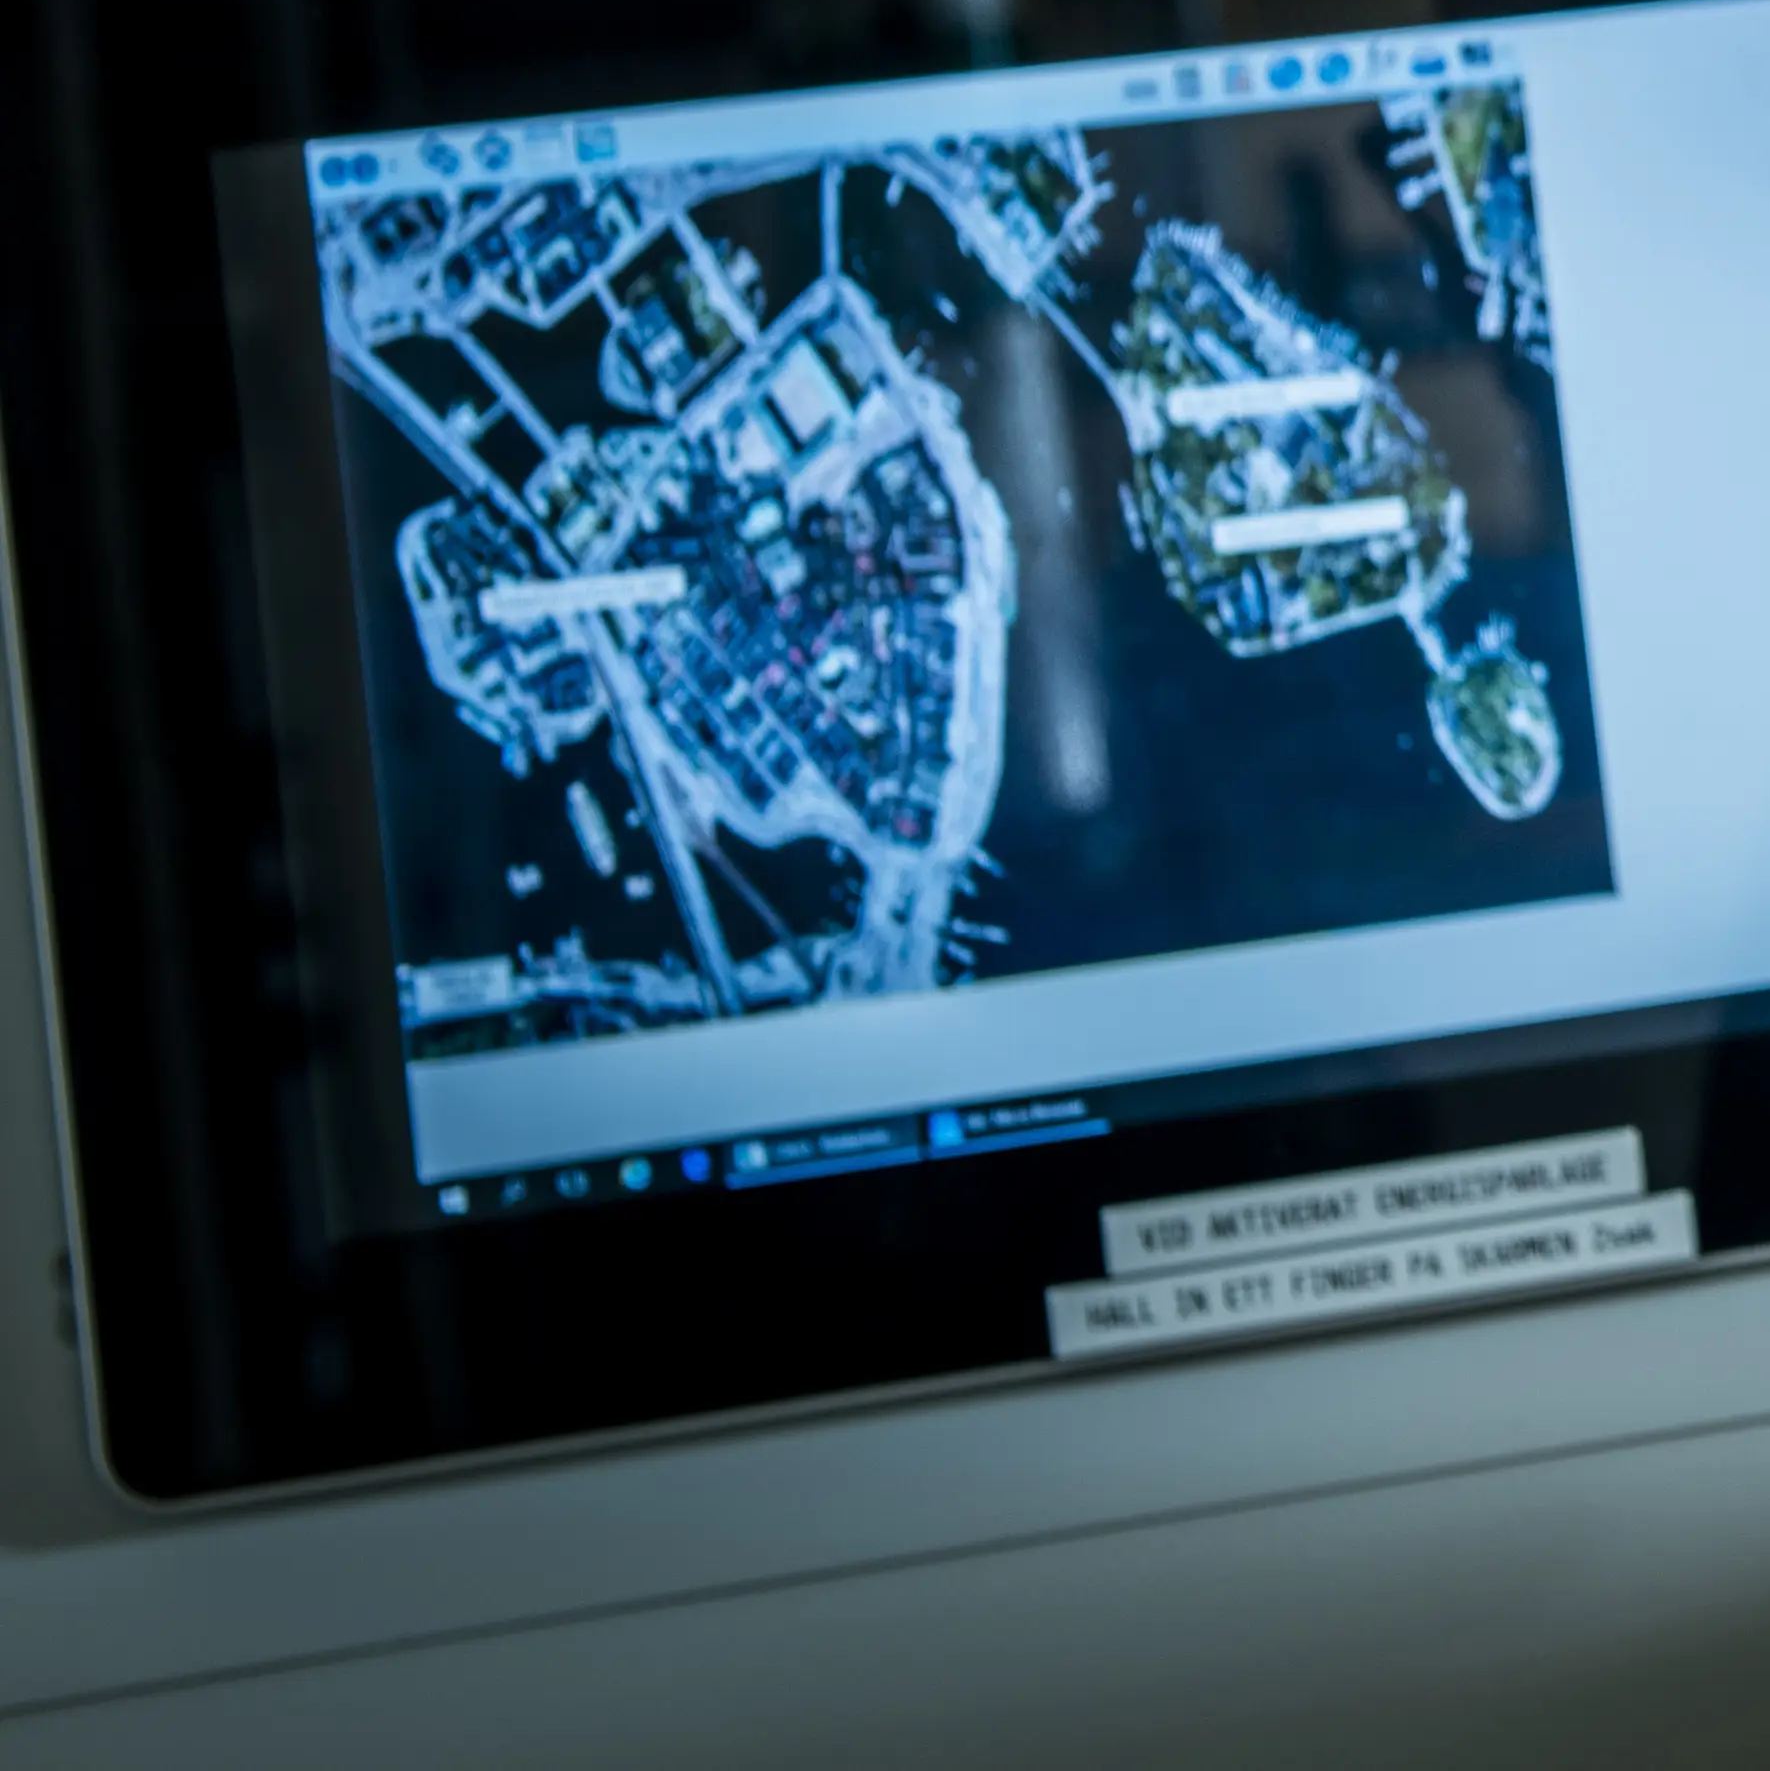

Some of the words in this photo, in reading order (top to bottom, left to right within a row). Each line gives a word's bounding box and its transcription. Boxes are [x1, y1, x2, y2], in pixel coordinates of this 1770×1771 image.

[1137, 1213, 1193, 1253] VID
[1206, 1188, 1357, 1243] AKTIVERAT
[1173, 1284, 1213, 1322] IN
[1221, 1271, 1273, 1314] ETT
[1287, 1254, 1394, 1301] FINGER
